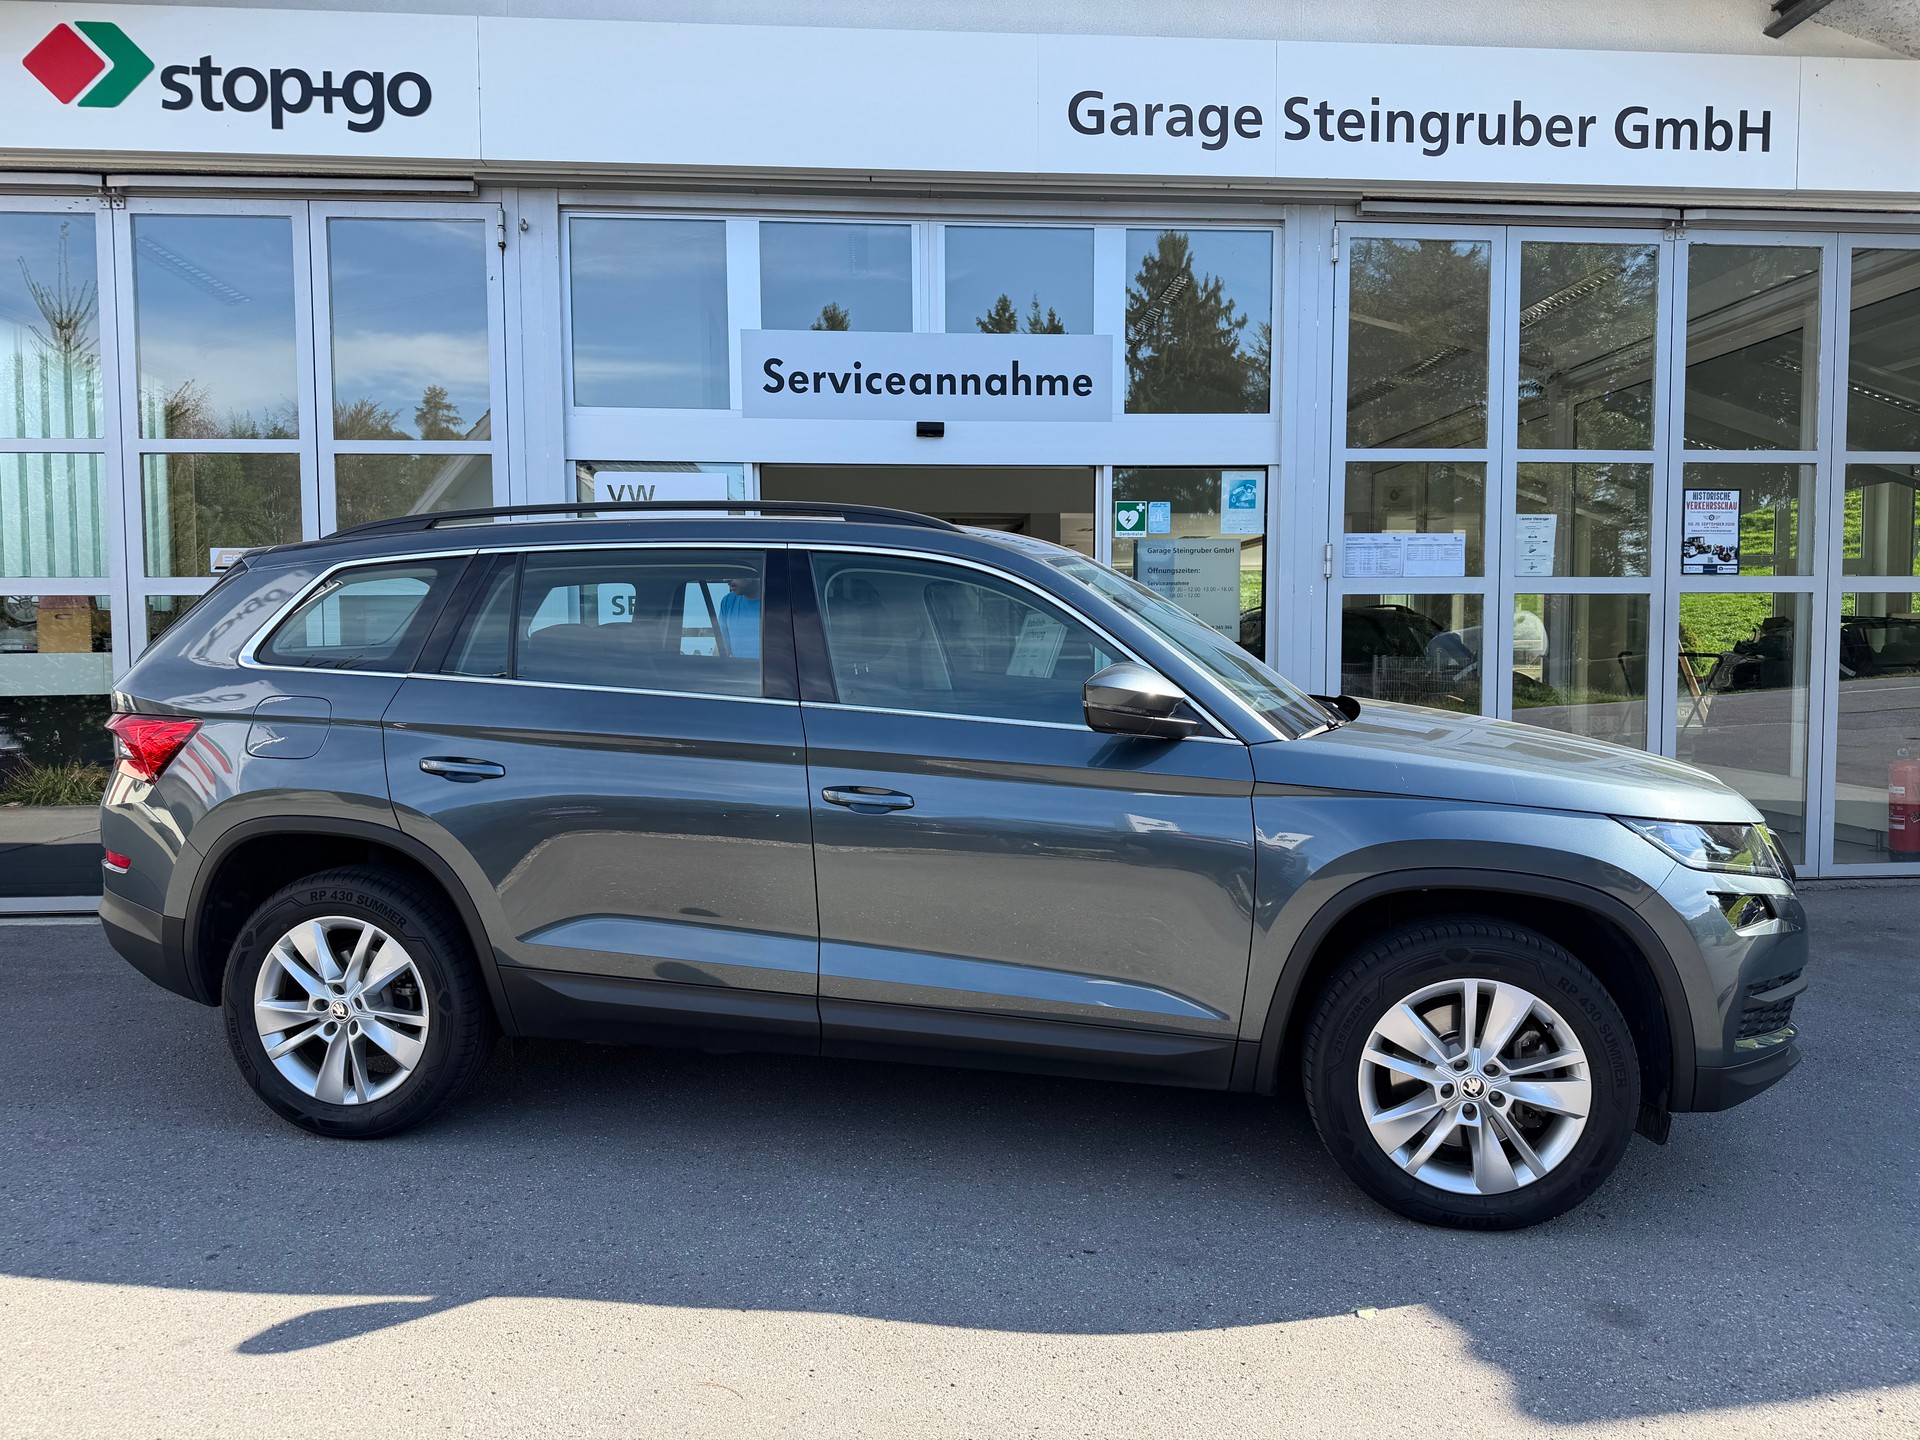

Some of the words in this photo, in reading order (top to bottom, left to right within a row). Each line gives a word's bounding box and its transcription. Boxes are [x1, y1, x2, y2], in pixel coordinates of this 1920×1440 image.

[161, 55, 432, 133] stop+go
[1067, 90, 1264, 150] Garage
[1283, 96, 1597, 157] Steingruber
[1614, 104, 1772, 153] GmbH
[762, 358, 1093, 397] Serviceannahme
[606, 484, 656, 501] VW
[1686, 501, 1738, 510] VERKEHRSSCHAU
[1692, 491, 1731, 501] HISTORISCHE
[1147, 547, 1172, 555] Garage
[1173, 547, 1212, 555] Steingruber
[1147, 567, 1201, 575] Öffnungszeiten:
[1679, 708, 1690, 716] CH
[310, 890, 326, 902] RP
[330, 890, 353, 902] 430
[357, 894, 407, 929] SUMMER
[1334, 995, 1371, 1054] 235/55ZR18
[1558, 977, 1579, 995] RP
[1579, 997, 1602, 1020] 430
[1600, 1024, 1628, 1088] SUMMER
